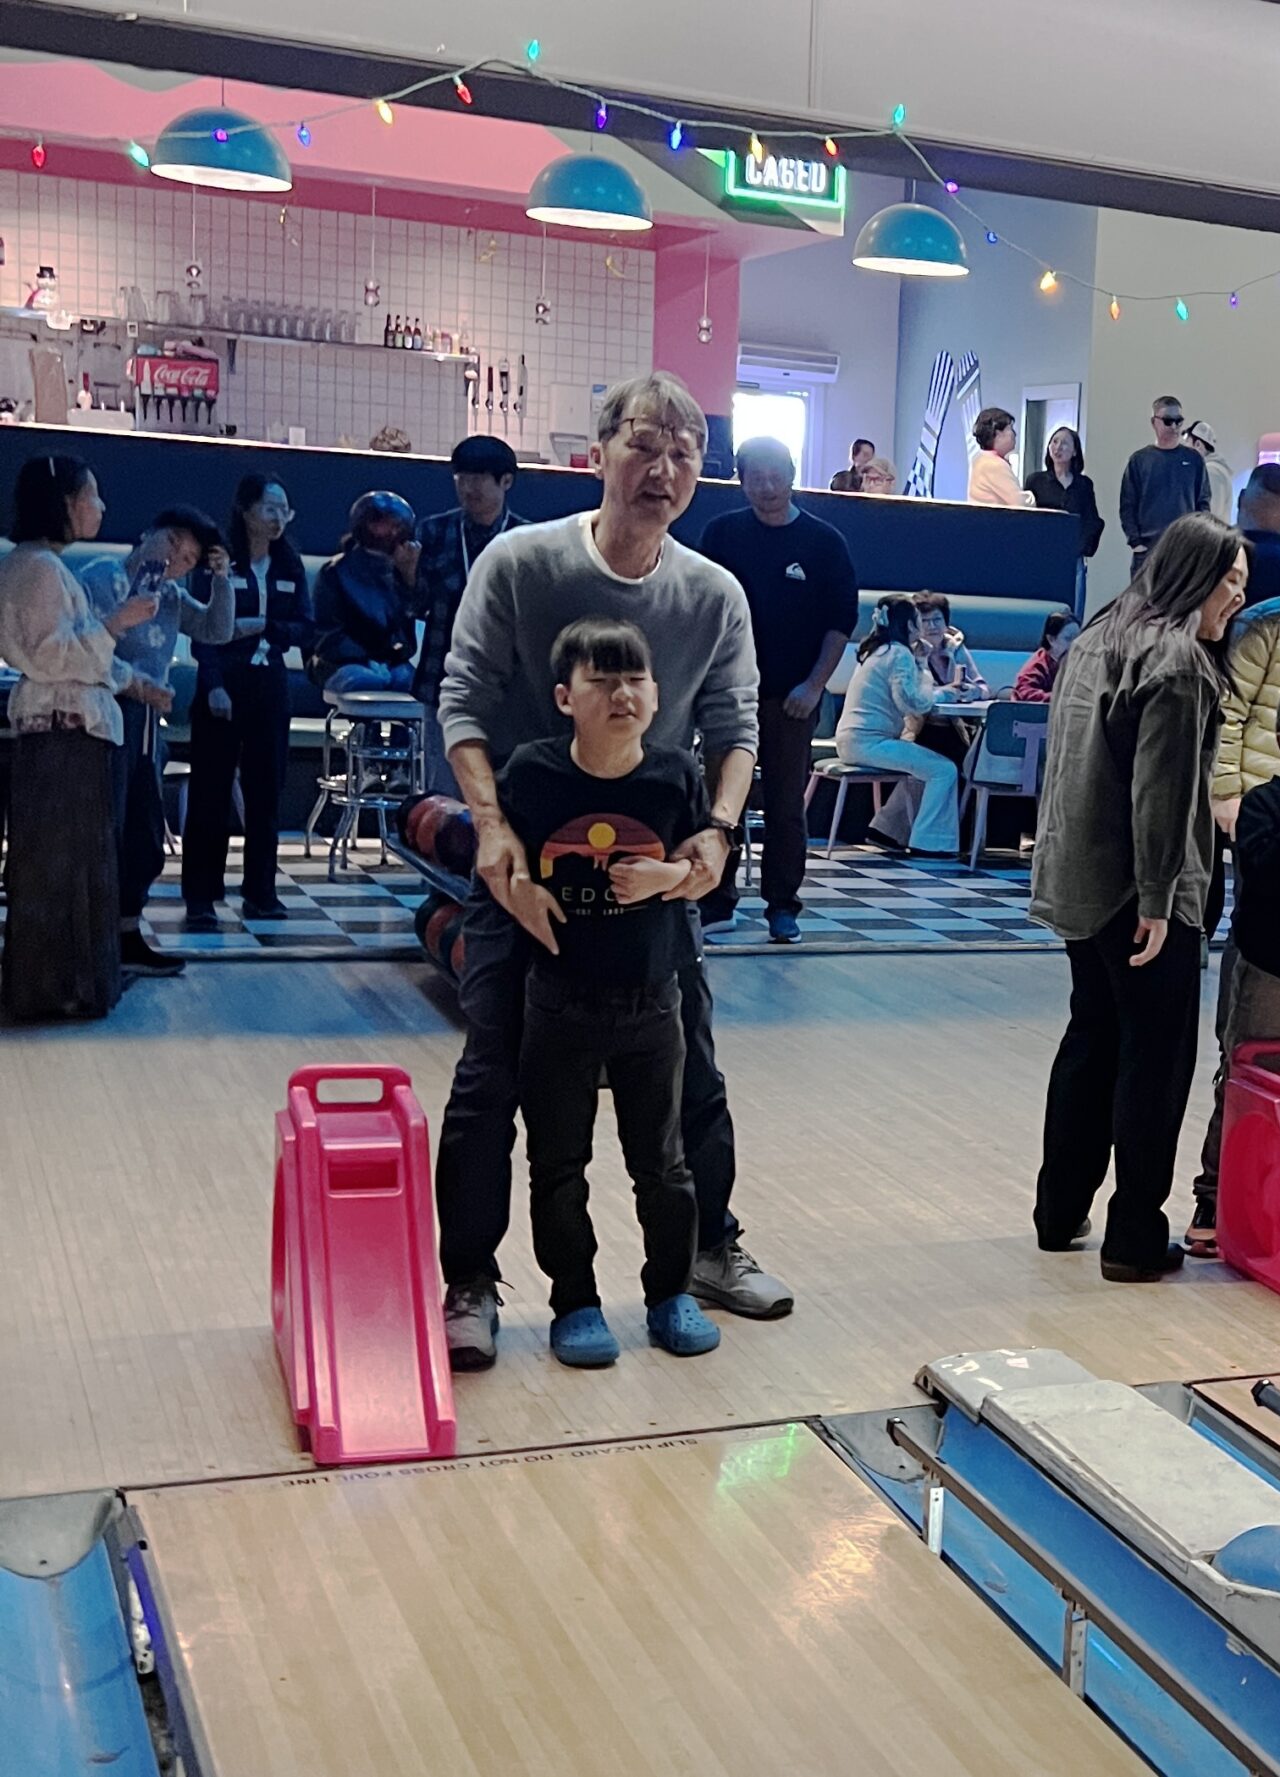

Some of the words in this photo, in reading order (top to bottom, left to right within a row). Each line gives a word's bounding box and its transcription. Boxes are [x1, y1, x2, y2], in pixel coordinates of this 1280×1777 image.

[657, 1437, 698, 1448] SLIP
[571, 1444, 652, 1458] HAZARD
[479, 1457, 519, 1469] NOT
[524, 1454, 553, 1463] DO
[398, 1462, 470, 1476] CROSS
[282, 1475, 331, 1487] LINE
[338, 1470, 394, 1483] FOUL
